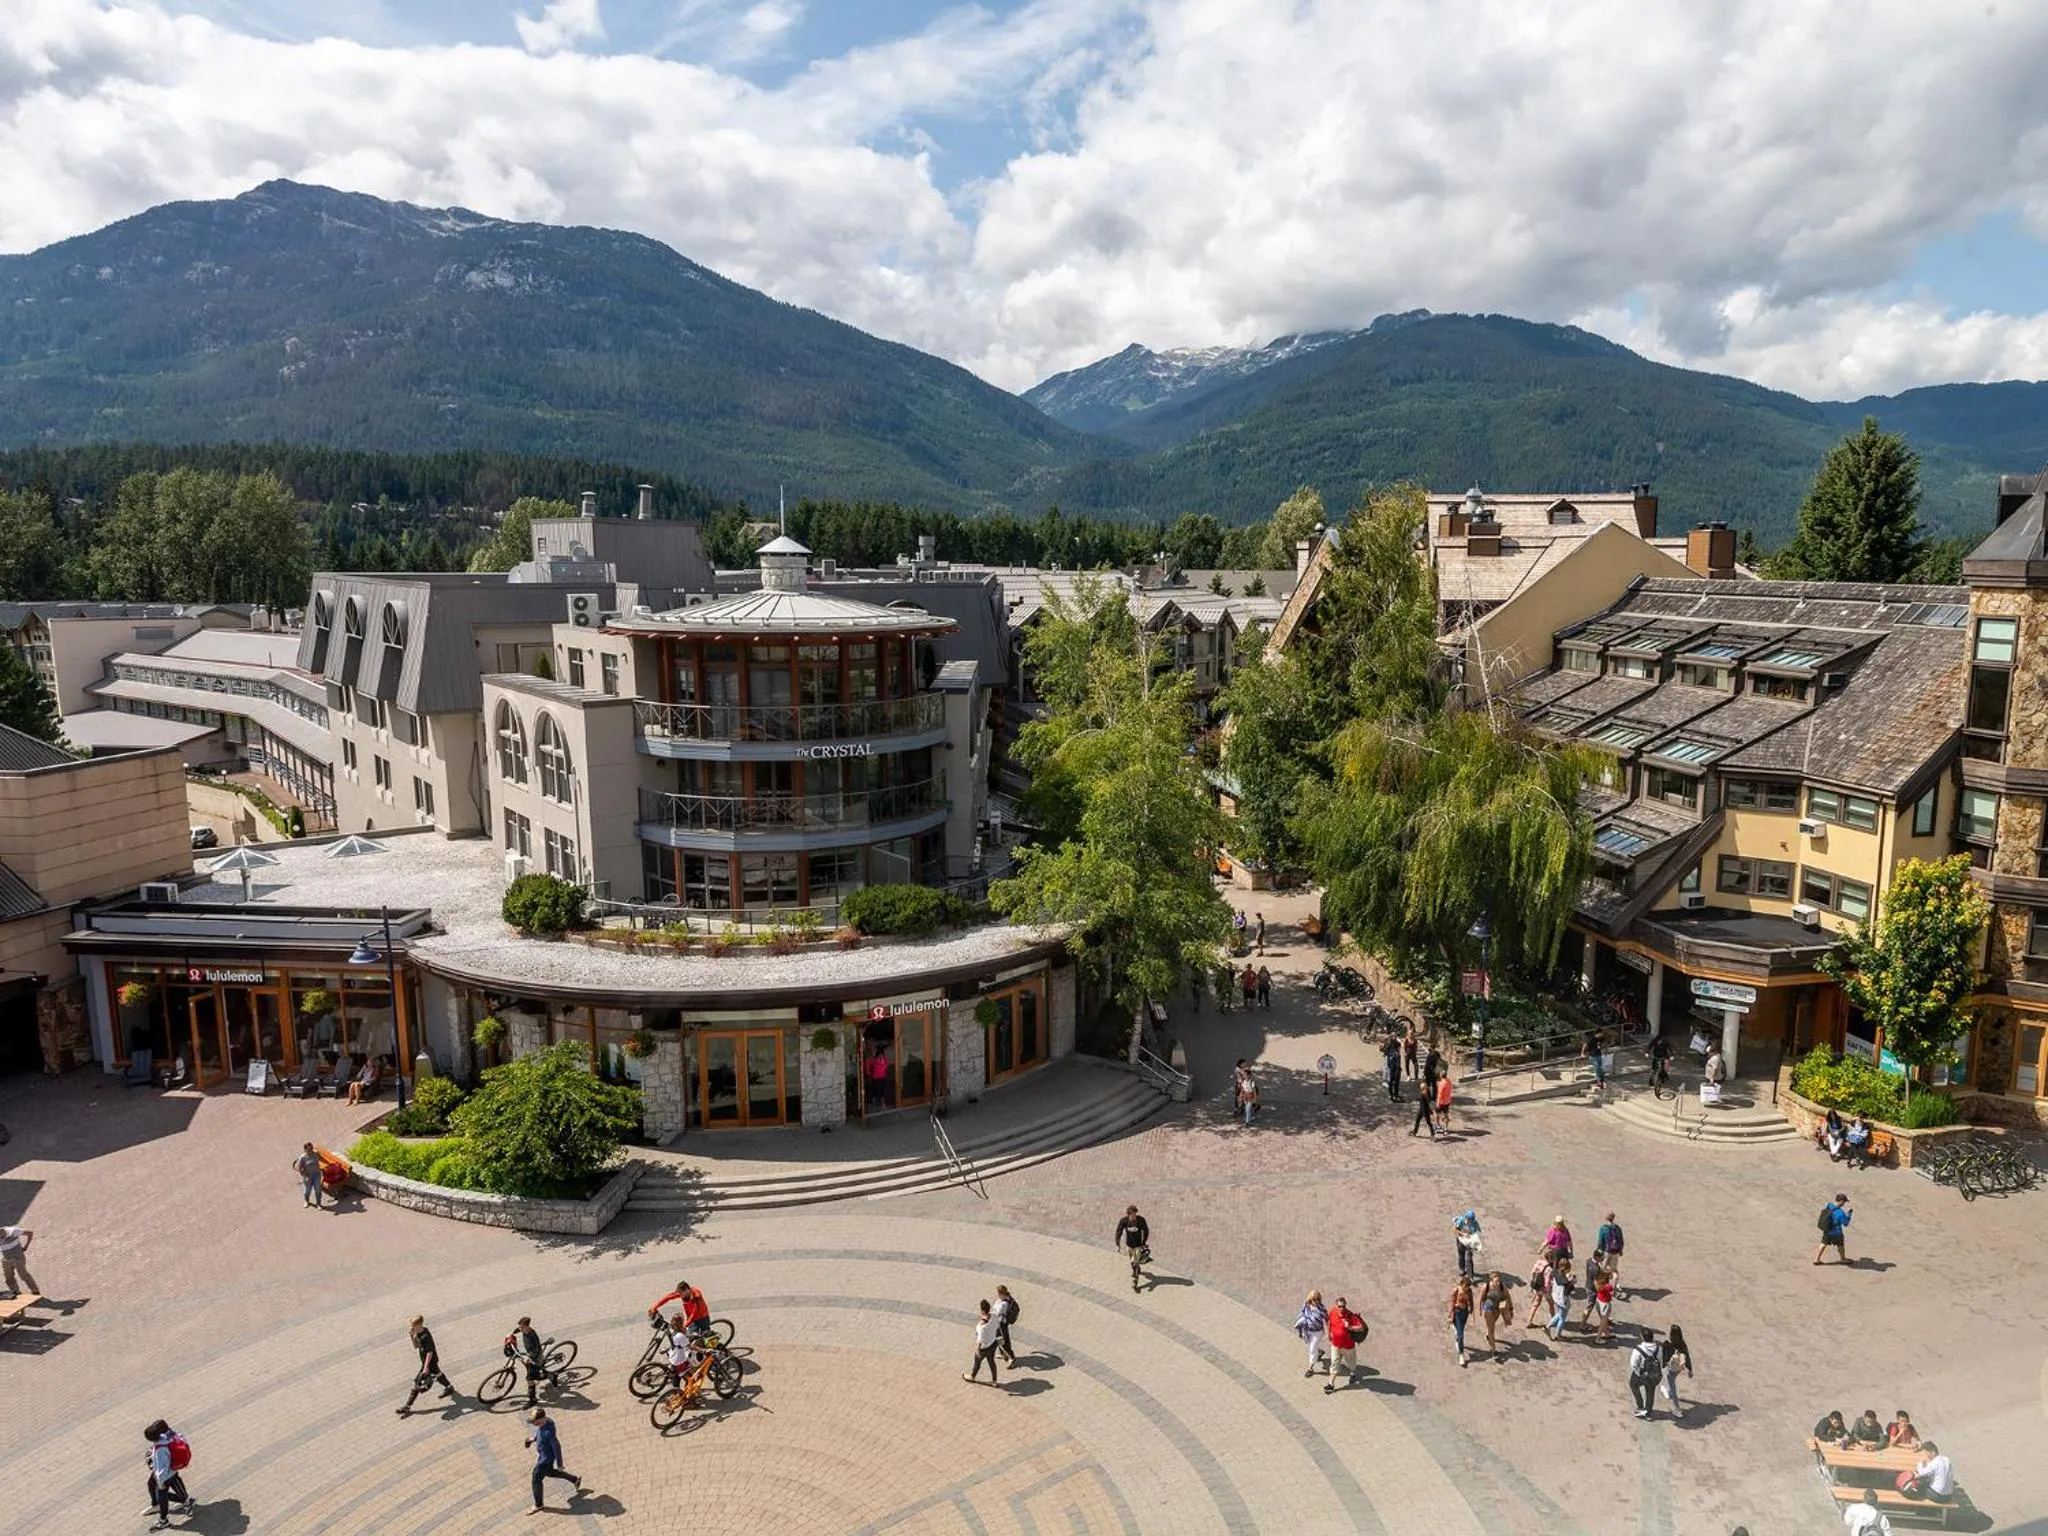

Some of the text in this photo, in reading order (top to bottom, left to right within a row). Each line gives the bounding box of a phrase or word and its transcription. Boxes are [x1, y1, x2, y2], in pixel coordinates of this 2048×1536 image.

[810, 743, 875, 759] CRYSTAL
[205, 969, 263, 983] lululemon
[889, 998, 950, 1017] lululemon
